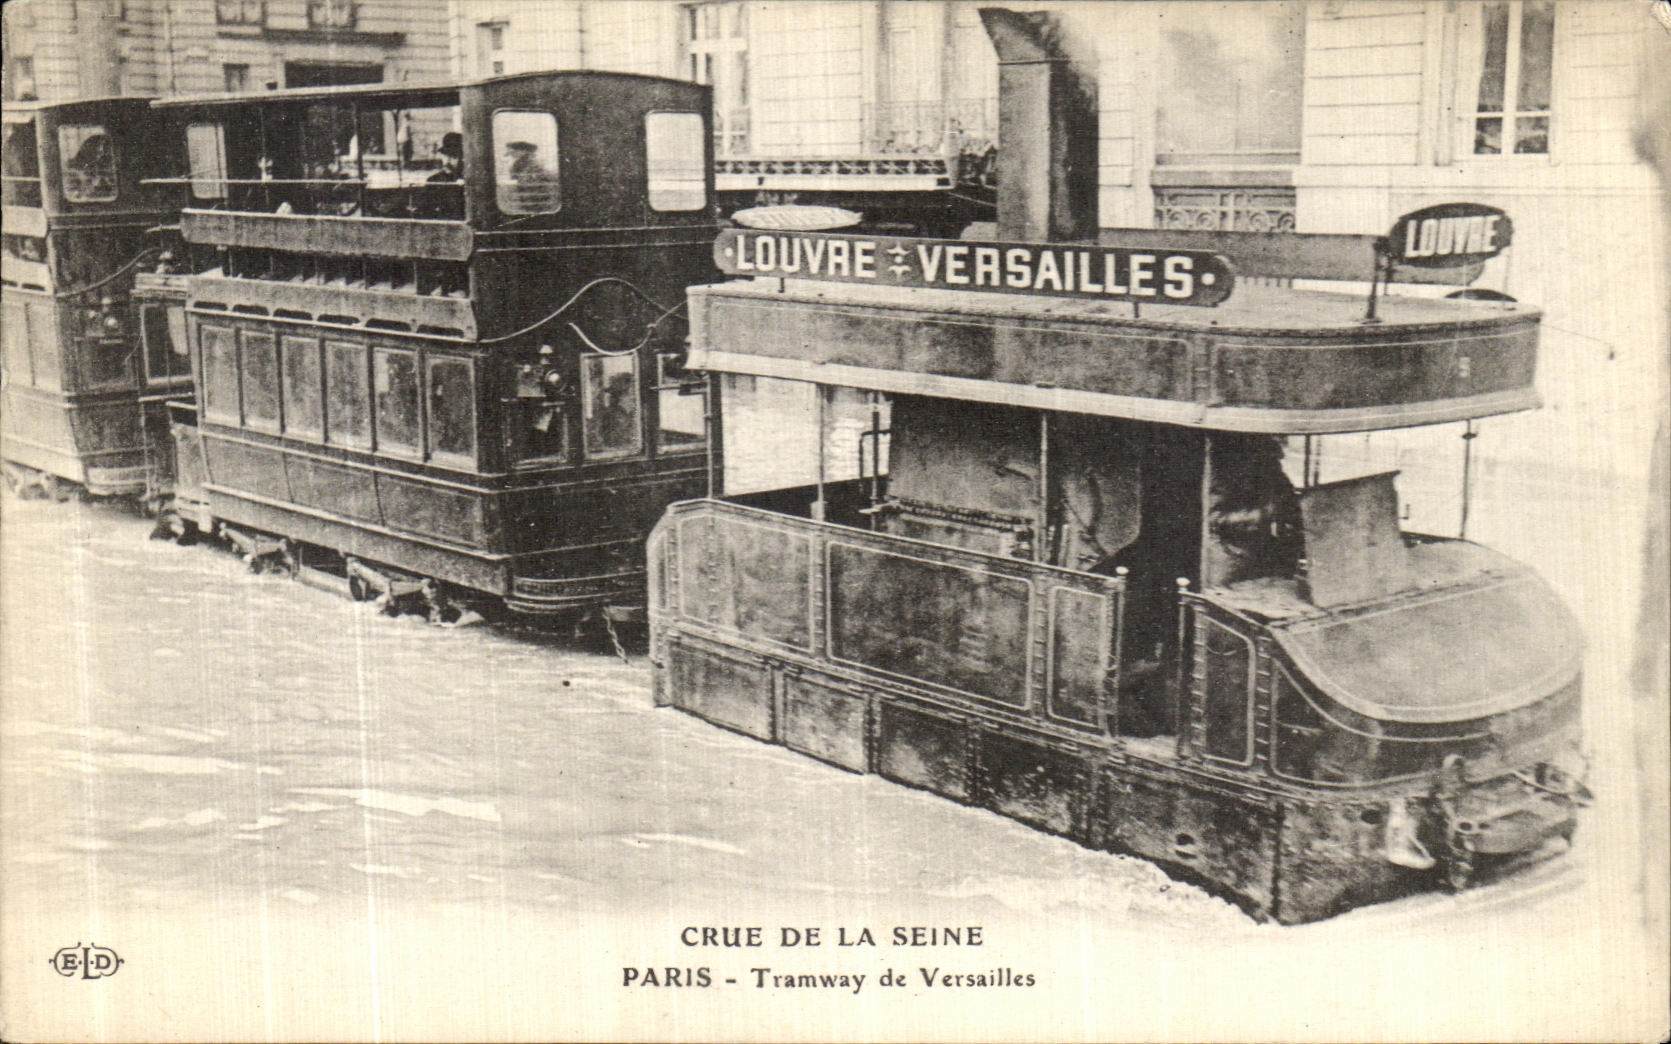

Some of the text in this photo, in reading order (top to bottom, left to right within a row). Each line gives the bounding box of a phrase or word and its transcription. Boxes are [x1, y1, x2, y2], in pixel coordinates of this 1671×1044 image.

[1405, 214, 1501, 258] LOUVRE
[736, 234, 1194, 299] LOUVRE VERSAILLES
